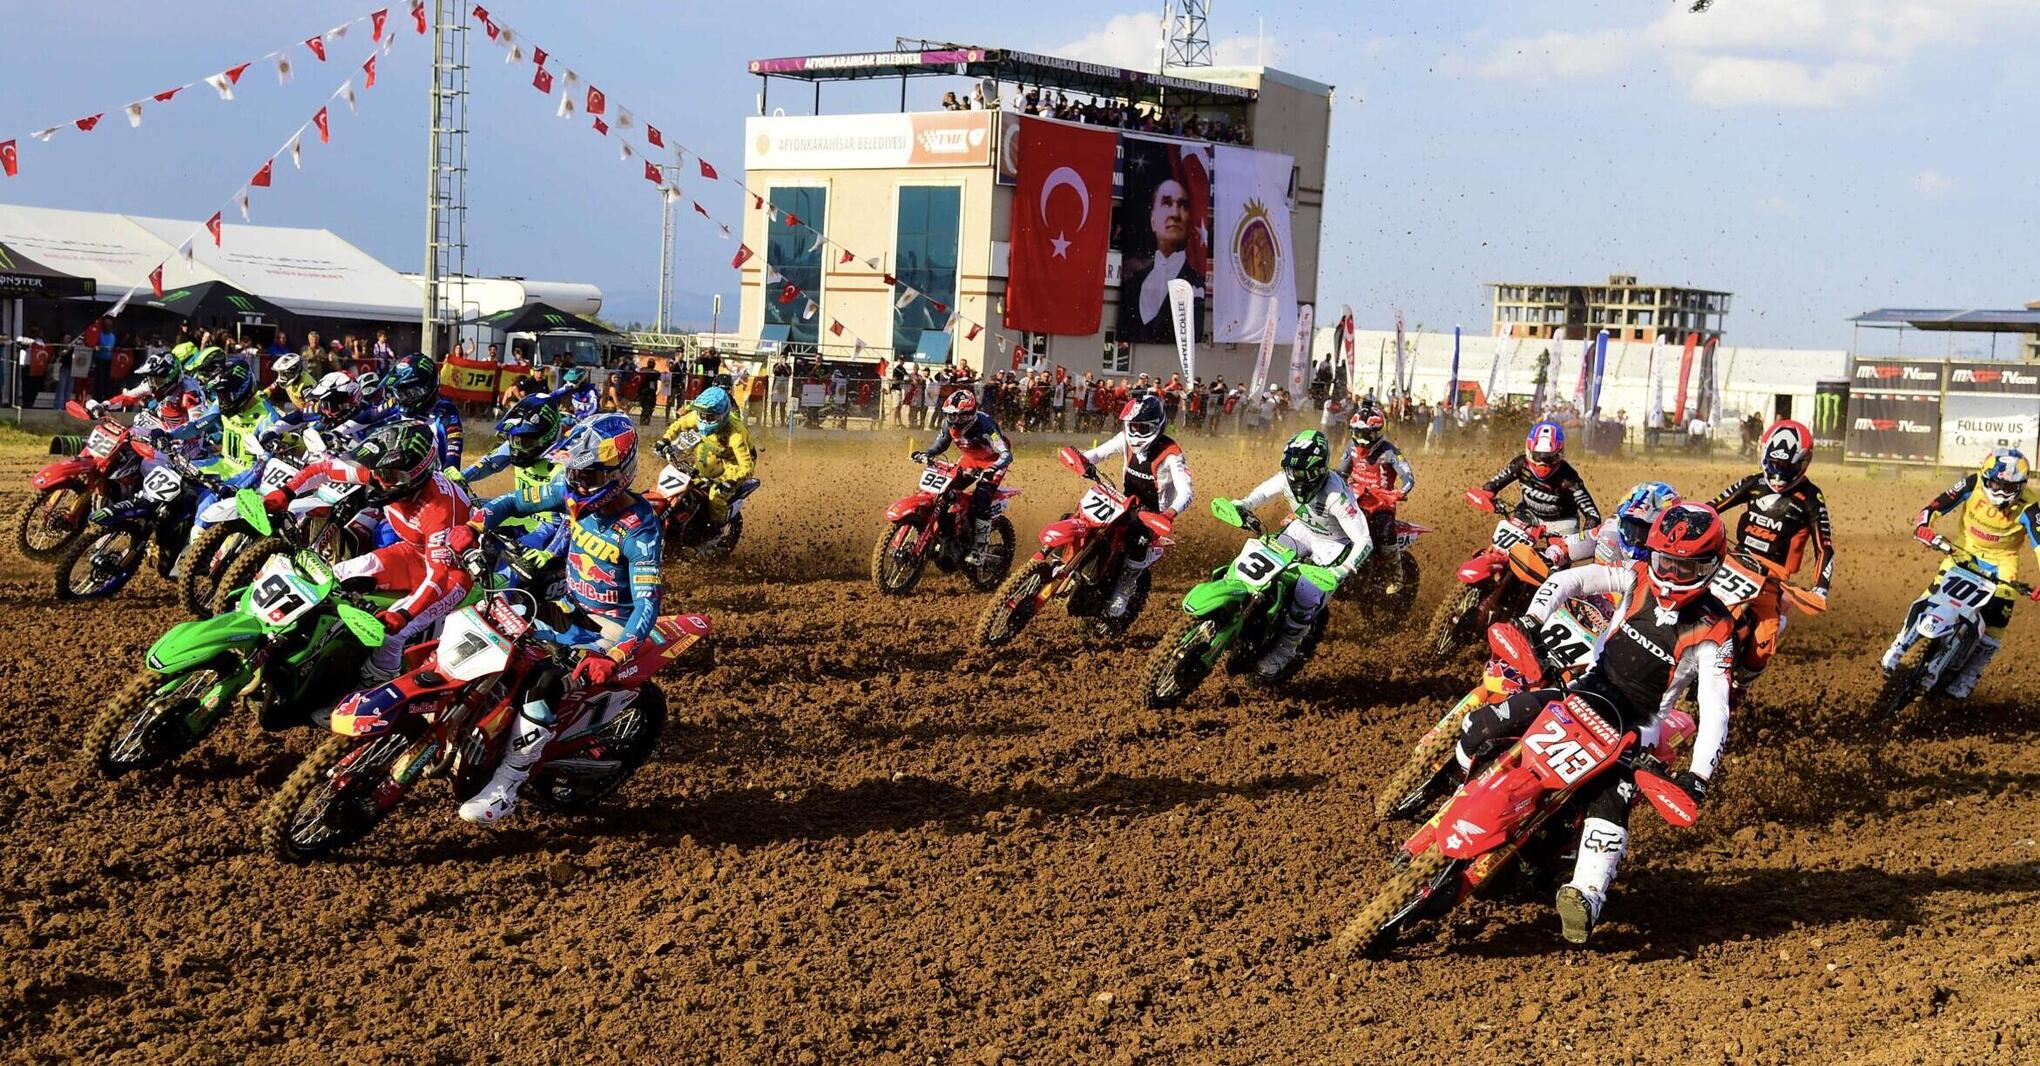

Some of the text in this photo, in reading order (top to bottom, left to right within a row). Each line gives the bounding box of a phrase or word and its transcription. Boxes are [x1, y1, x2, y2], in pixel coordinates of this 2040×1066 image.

[1957, 419, 2023, 433] FOLLOW US
[88, 432, 116, 458] 32
[144, 470, 180, 500] 132
[659, 475, 685, 490] 17
[921, 473, 948, 489] 92
[1084, 495, 1116, 522] 70
[1748, 511, 1783, 531] TEM
[1492, 528, 1531, 550] 30
[1237, 551, 1275, 581] 3
[251, 573, 306, 614] 91
[1535, 581, 1559, 607] FOX
[1942, 576, 1990, 607] 101
[449, 630, 491, 669] 1
[1540, 623, 1592, 665] 84
[1619, 618, 1676, 666] HONDA
[1566, 700, 1615, 745] RENTHAL
[1524, 719, 1598, 784] 243
